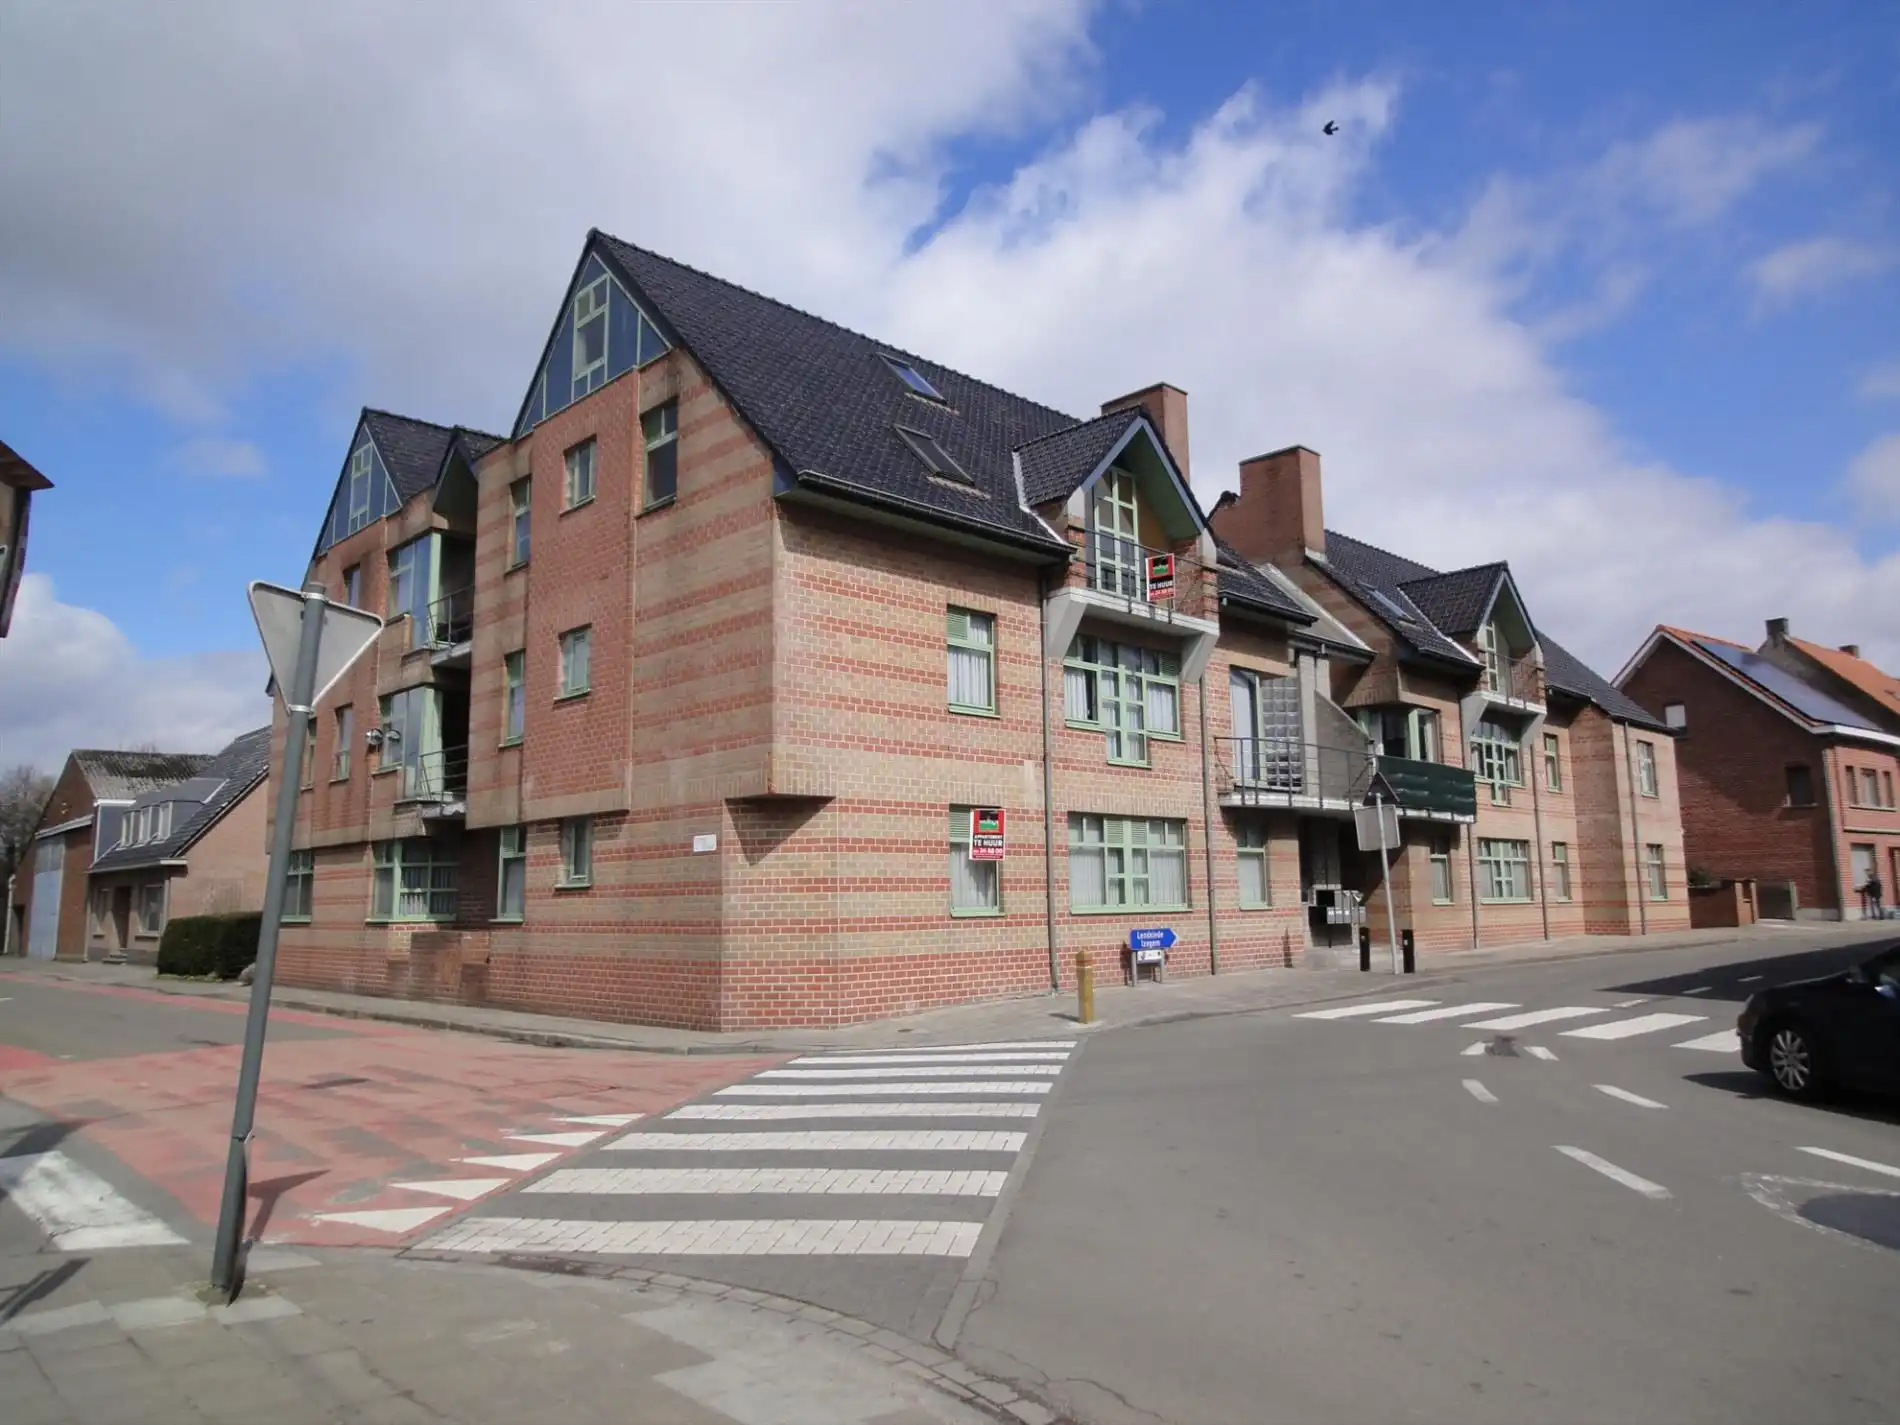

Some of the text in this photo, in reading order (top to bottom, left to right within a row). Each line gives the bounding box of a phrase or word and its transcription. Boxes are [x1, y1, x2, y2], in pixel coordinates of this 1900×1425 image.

[1157, 580, 1173, 589] HUUR
[974, 839, 1003, 847] TE HUUR
